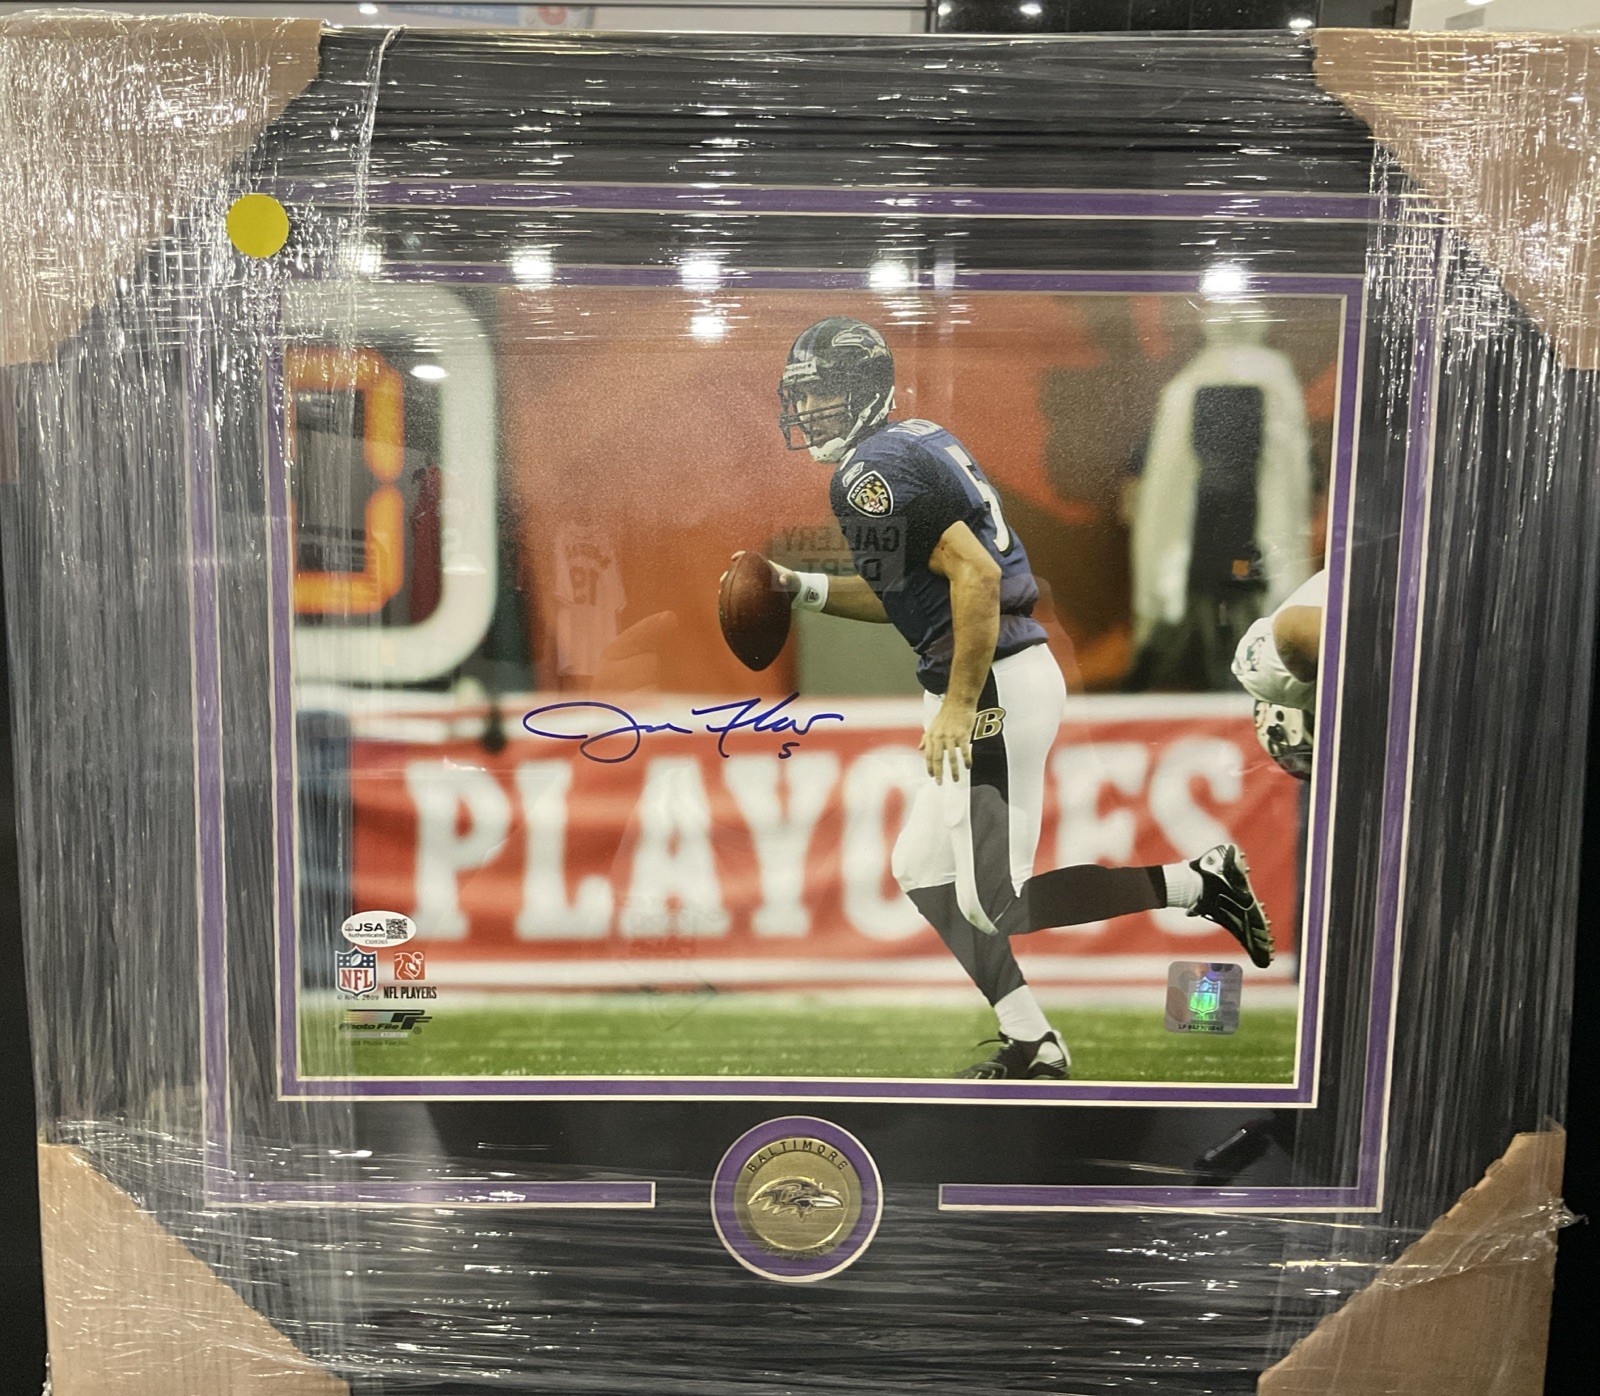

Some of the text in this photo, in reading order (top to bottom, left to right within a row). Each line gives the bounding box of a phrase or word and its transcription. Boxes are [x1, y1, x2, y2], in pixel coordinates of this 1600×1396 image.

[973, 707, 1006, 741] B
[405, 735, 1244, 942] PLAYOFS
[355, 922, 385, 932] JSA
[341, 969, 373, 991] NFL
[383, 986, 437, 999] NFL PLAYERS
[747, 1140, 848, 1173] BALTIMORE
